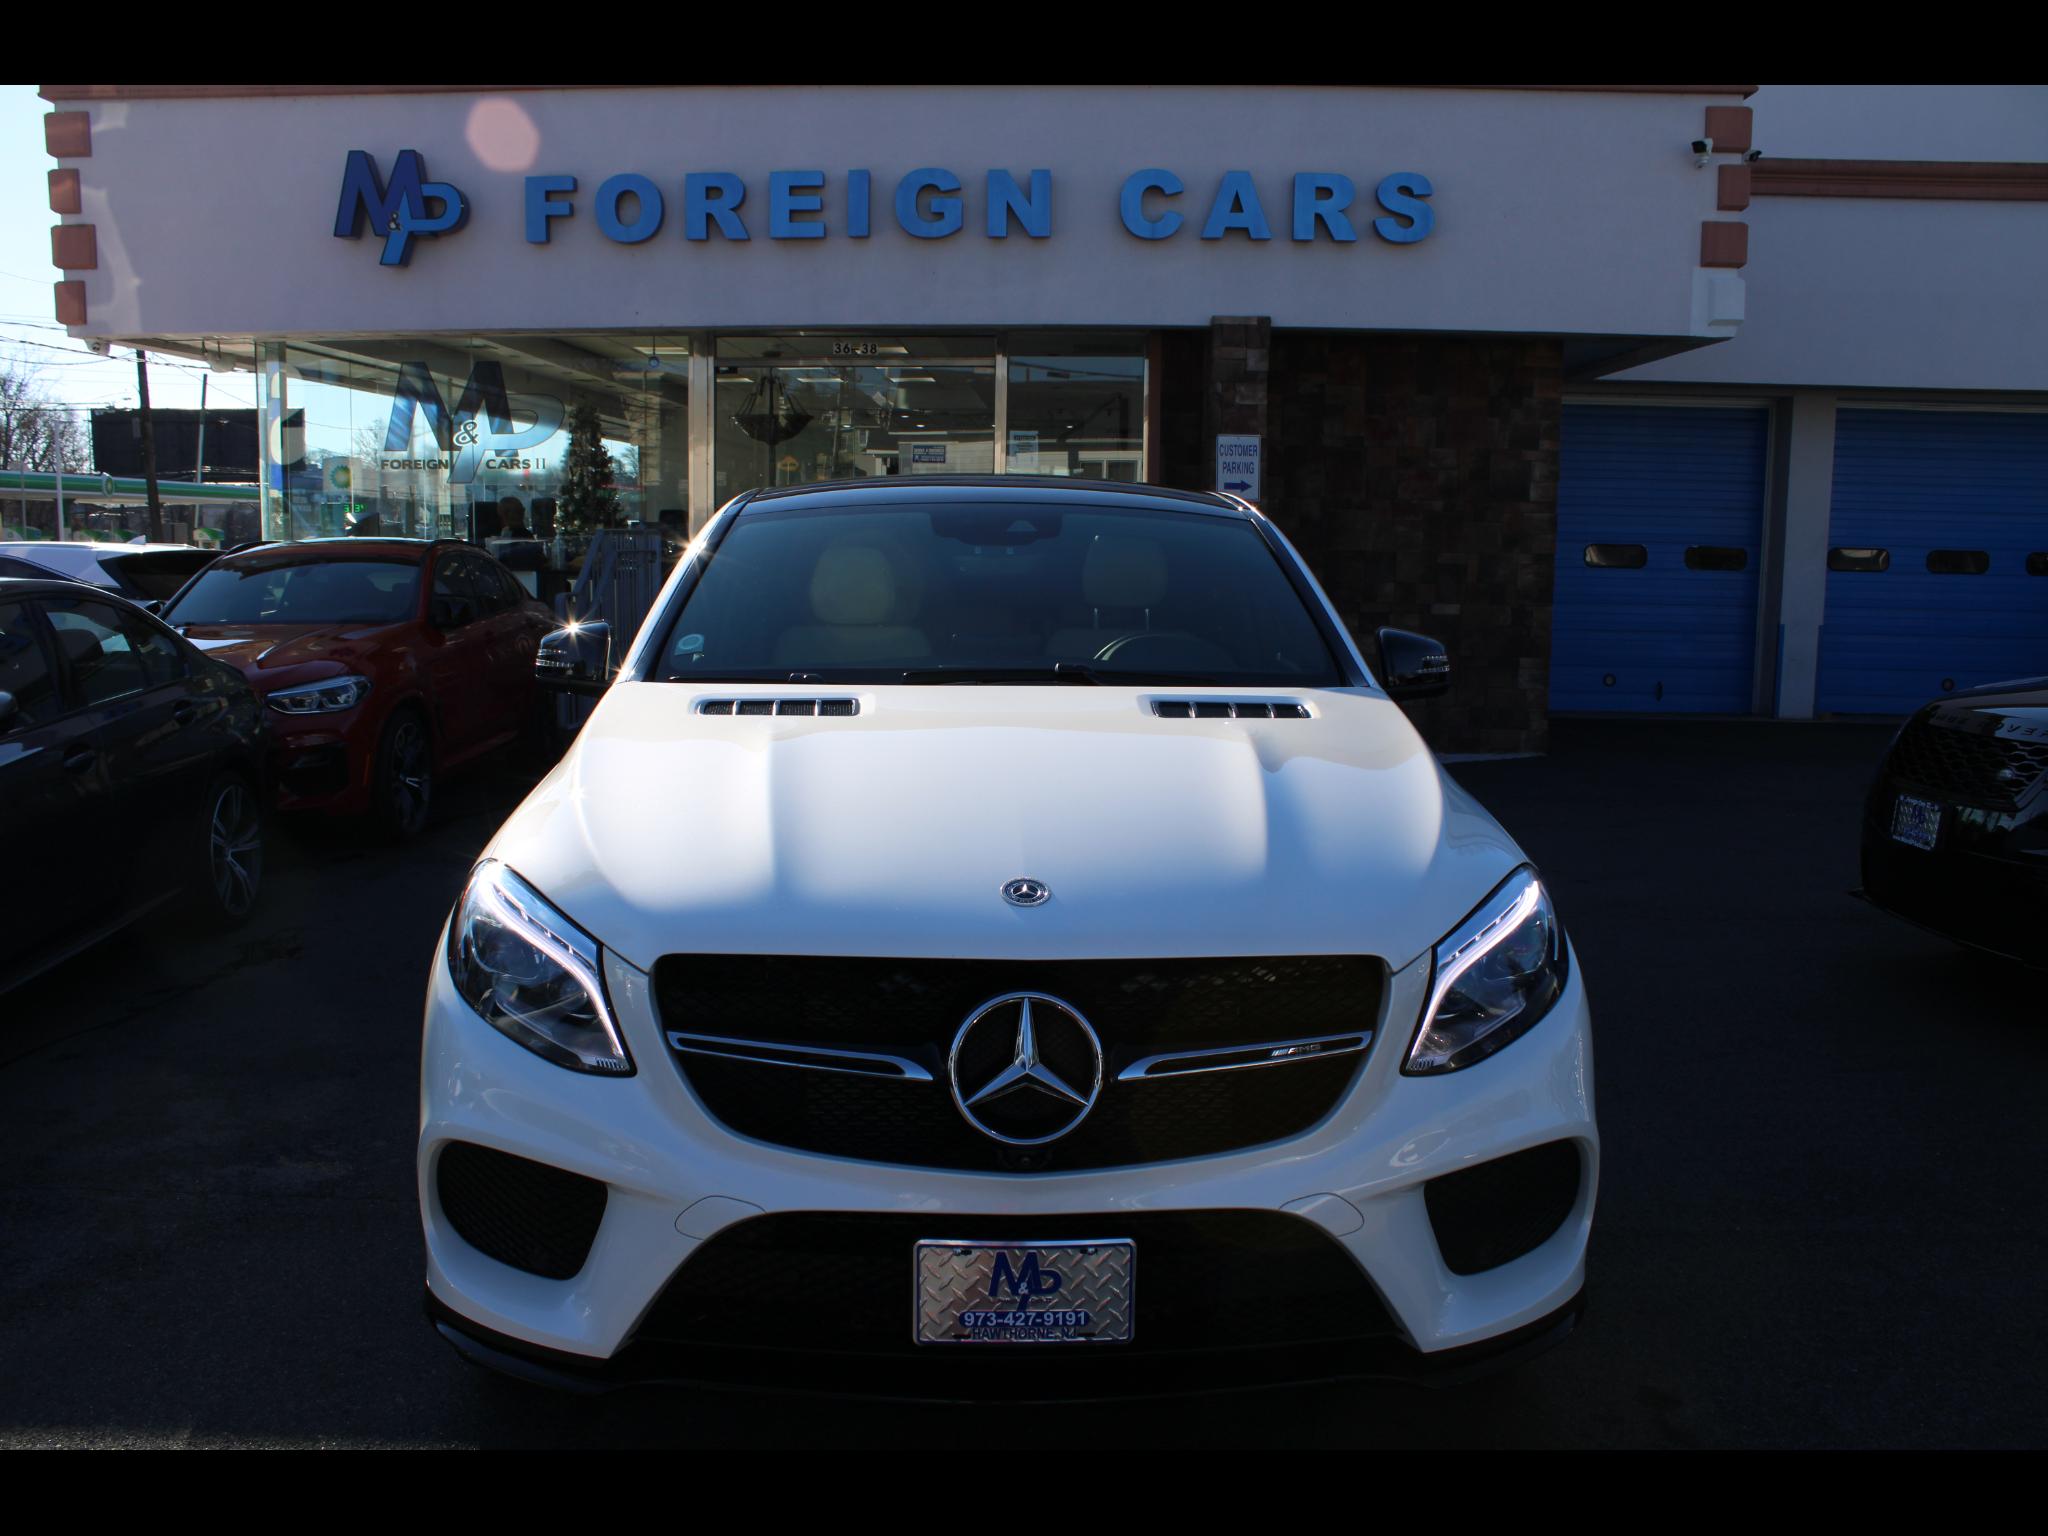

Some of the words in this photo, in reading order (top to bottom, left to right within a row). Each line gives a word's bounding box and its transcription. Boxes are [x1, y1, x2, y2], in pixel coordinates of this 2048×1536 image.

[525, 166, 1053, 245] FOREIGN
[1119, 168, 1437, 244] CARS
[1219, 444, 1258, 457] CUSTOMER
[380, 459, 449, 471] FOREIGN
[485, 458, 531, 470] CARS
[1222, 461, 1255, 475] PARKING
[962, 1311, 1087, 1327] 973-427-9191
